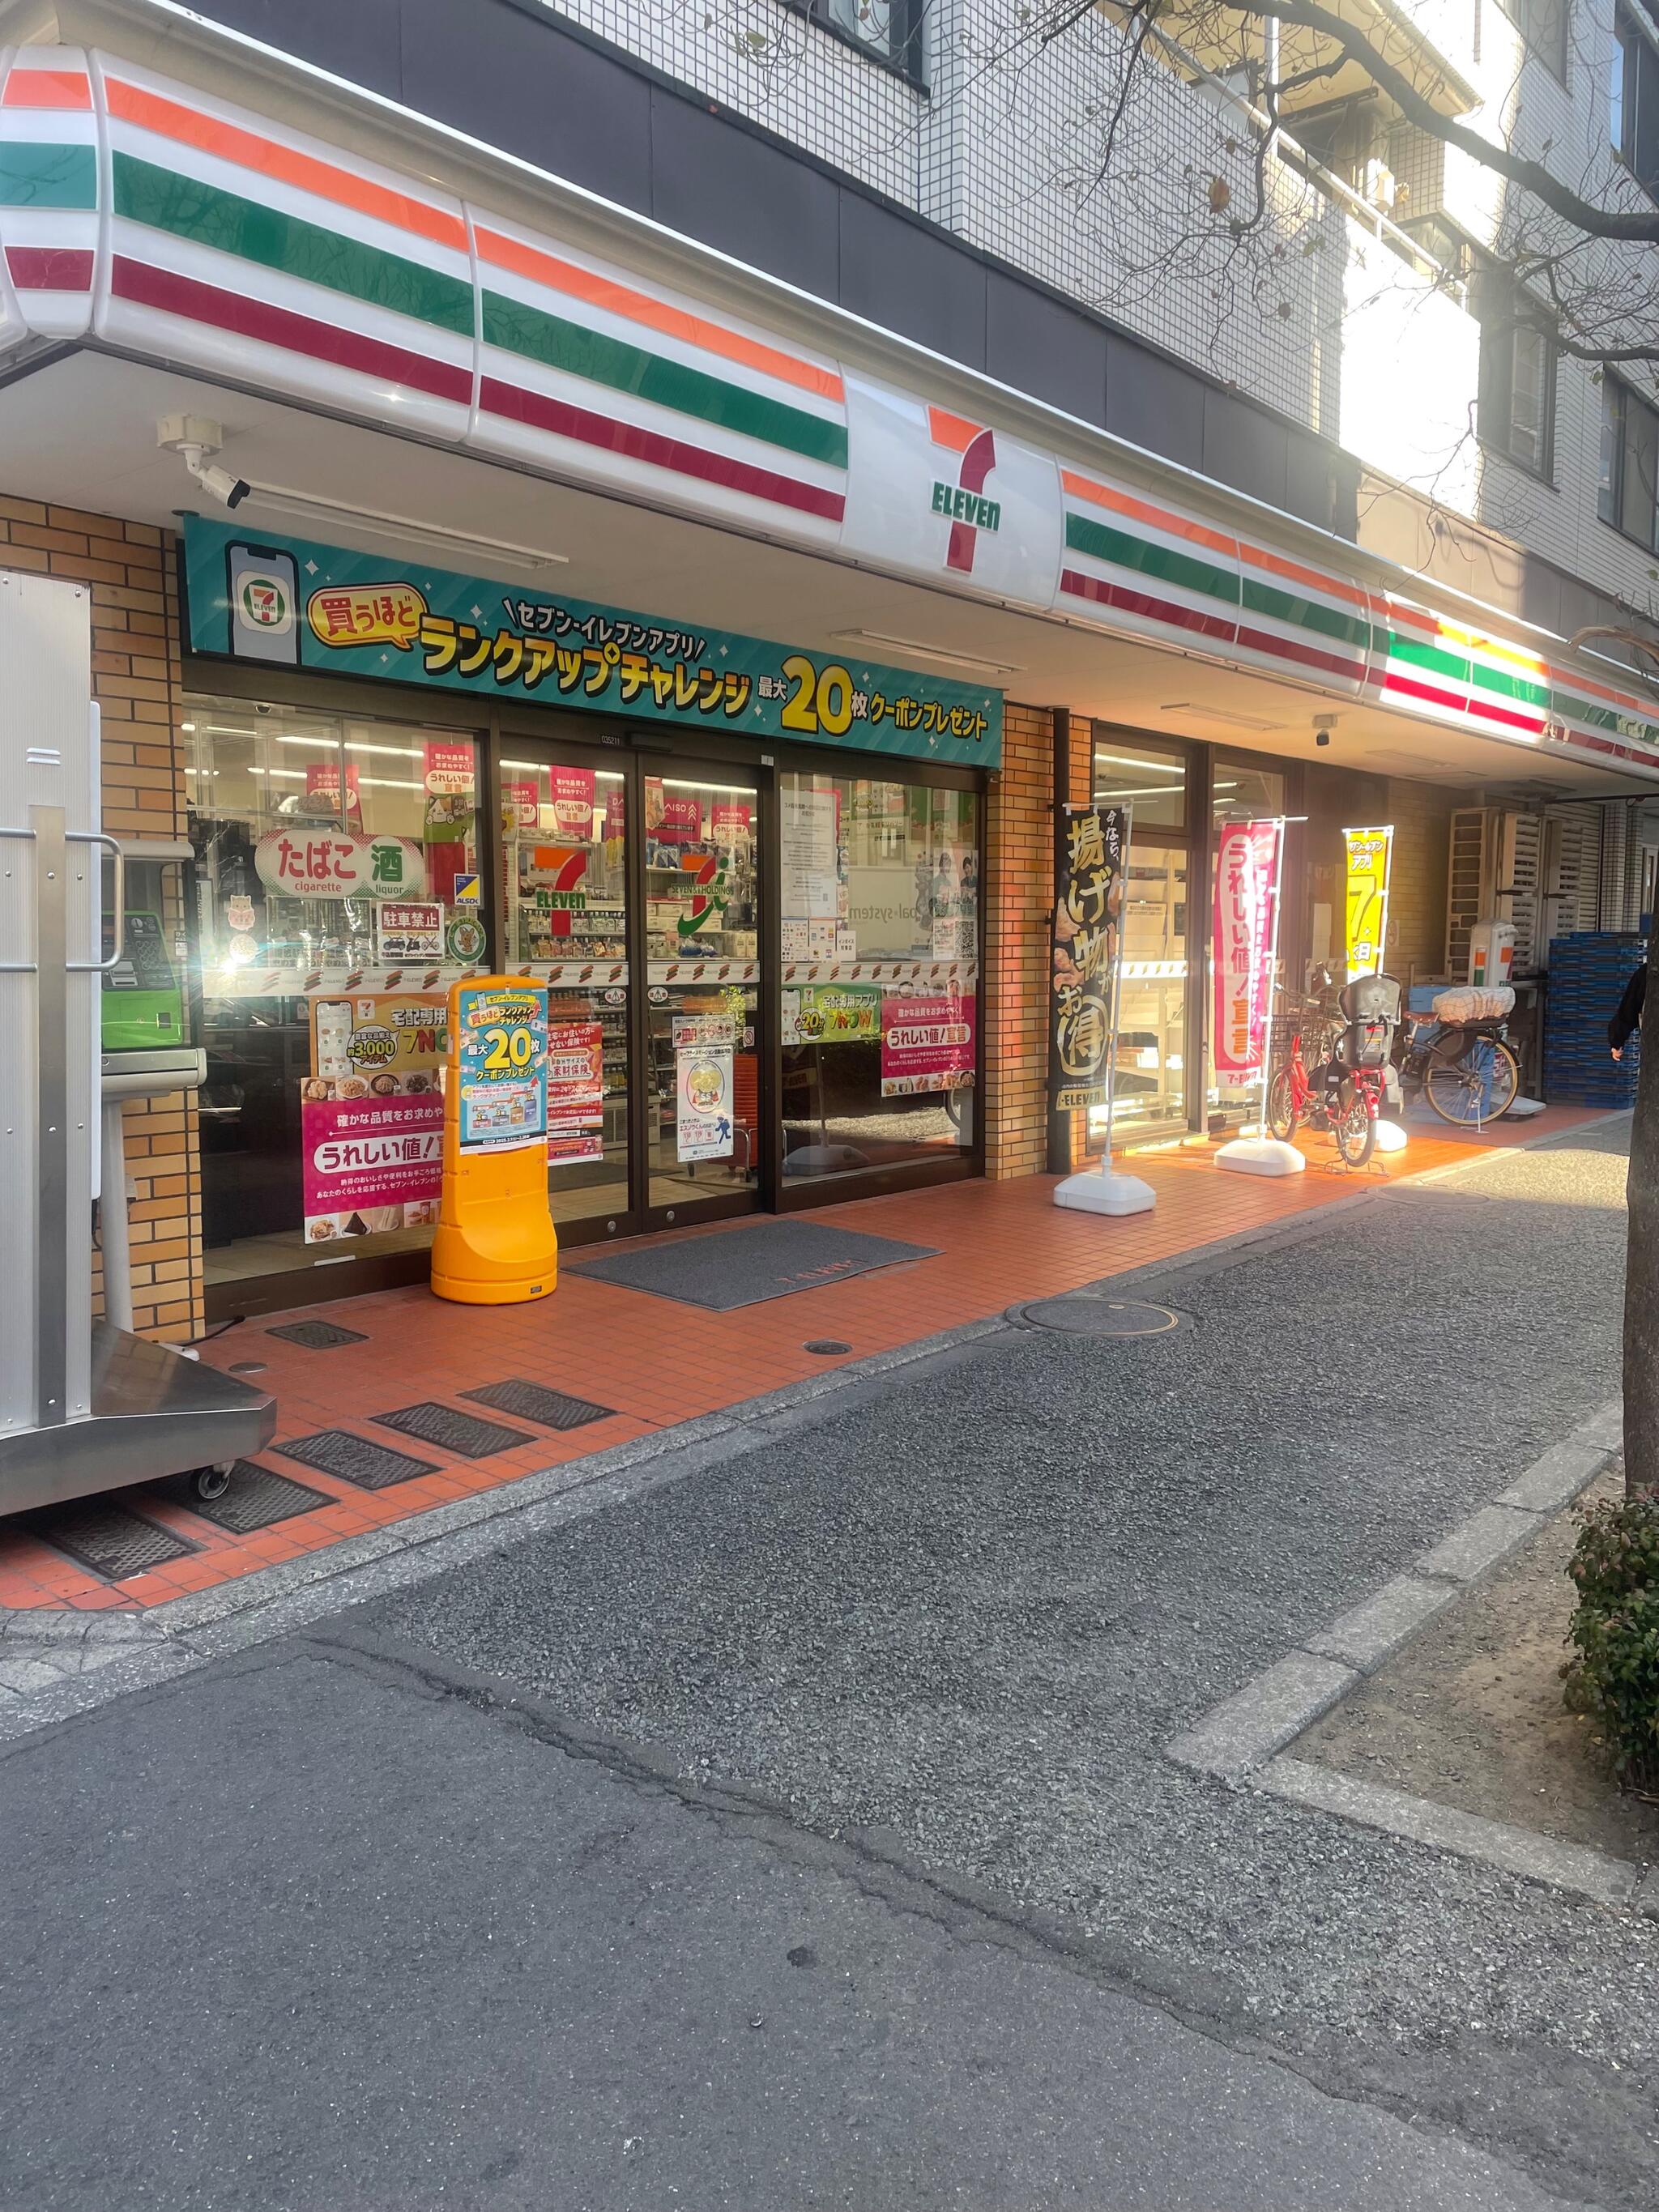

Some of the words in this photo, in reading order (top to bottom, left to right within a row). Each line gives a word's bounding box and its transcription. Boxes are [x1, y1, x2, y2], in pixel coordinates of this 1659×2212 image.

[932, 481, 1001, 531] ELEVEN
[254, 603, 275, 613] ELEVEN
[320, 595, 416, 637] 買うほど
[420, 615, 750, 714] ランクアップチャレンジ
[277, 837, 357, 880] たばこ
[370, 844, 403, 884] 酒
[294, 880, 342, 893] cigarette
[375, 884, 403, 895] liquor
[535, 891, 586, 910] ELEVEN
[383, 911, 438, 927] 駐車禁止
[391, 1008, 447, 1027] 宅配専用
[471, 1008, 500, 1025] 買うほど
[499, 1005, 533, 1016] ランクアップ
[891, 1025, 967, 1047] うれしい値!宣言
[360, 1055, 388, 1065] アイテム
[476, 1067, 535, 1081] クーポンプレゼント
[553, 1063, 590, 1076] 家財保険
[336, 1106, 444, 1128] 確かな品質をお求めや
